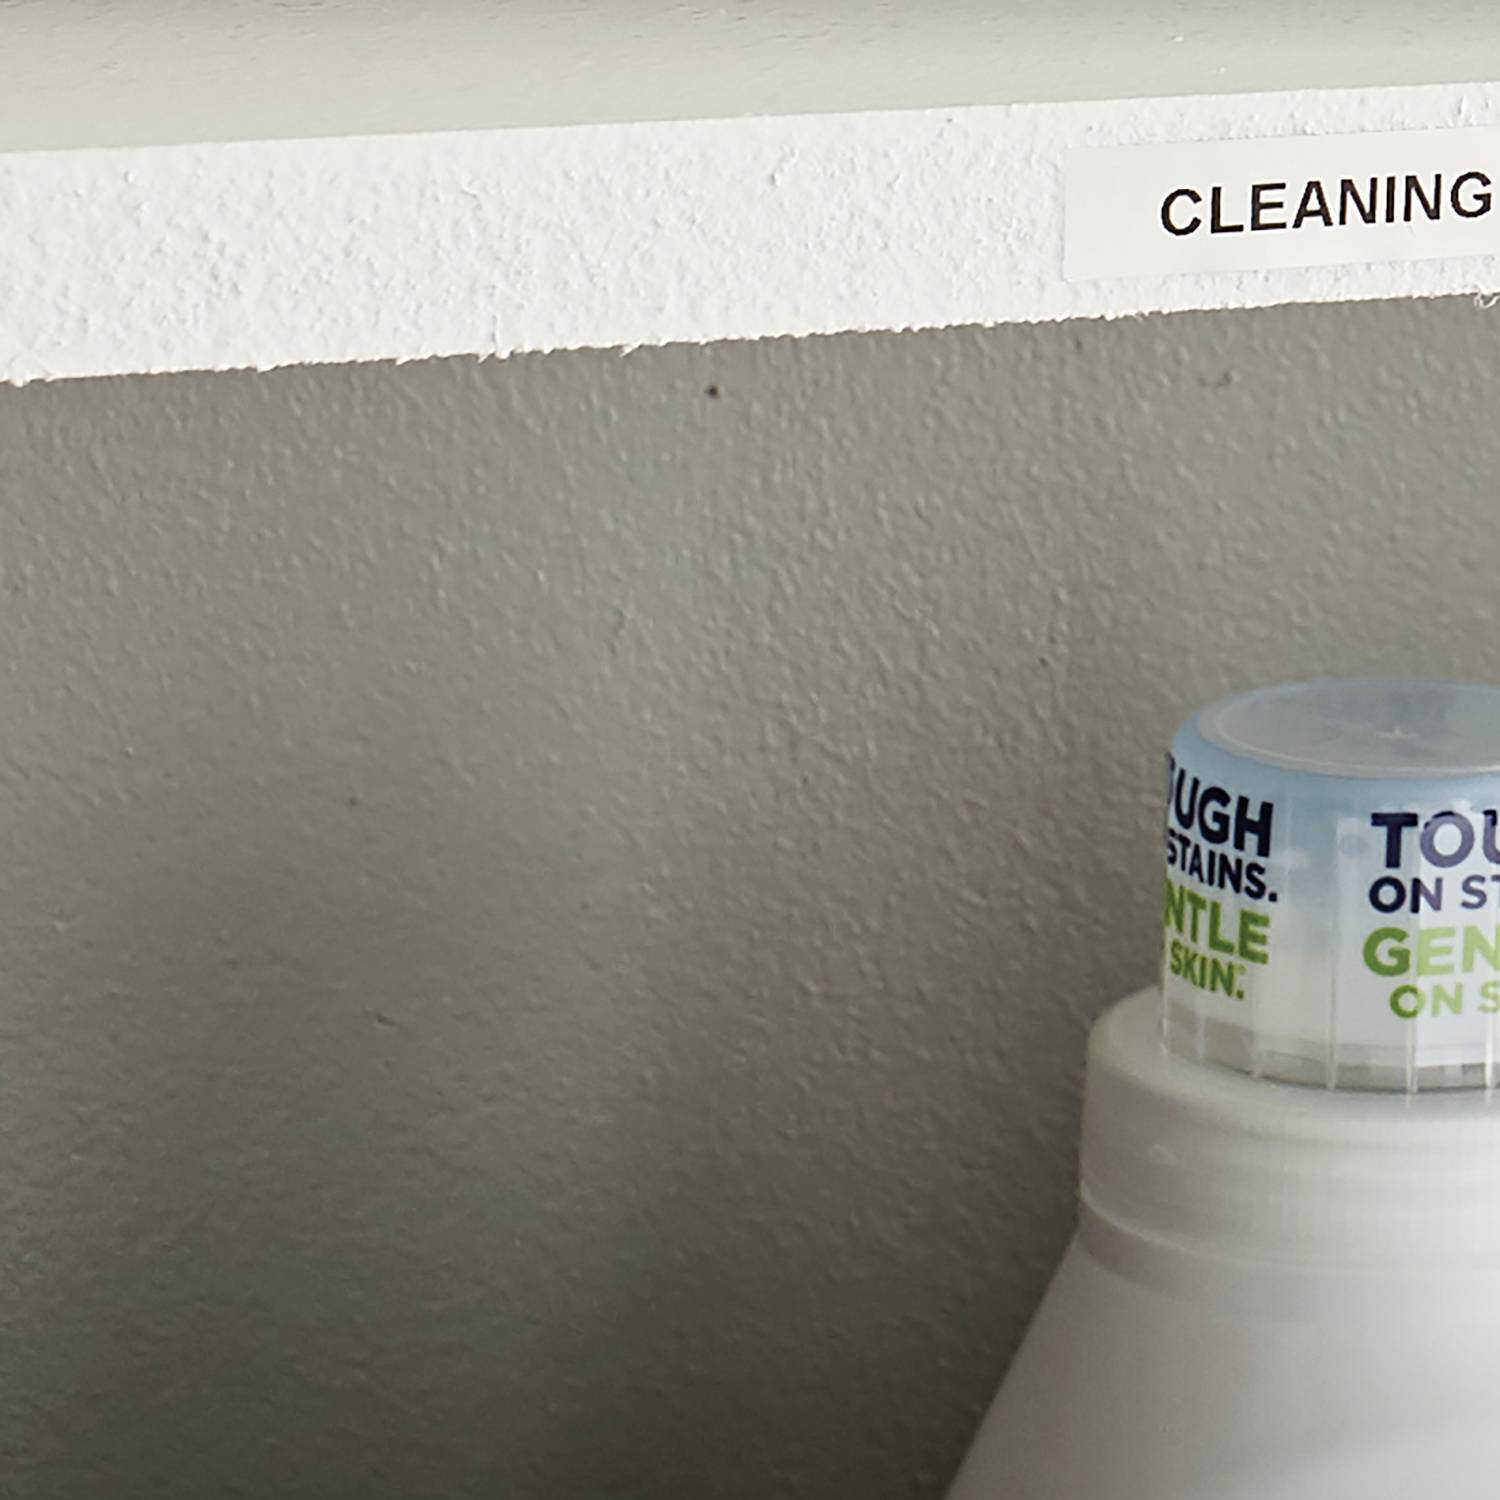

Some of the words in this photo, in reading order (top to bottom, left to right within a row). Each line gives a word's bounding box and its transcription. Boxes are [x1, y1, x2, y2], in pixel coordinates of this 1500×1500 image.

[1160, 171, 1492, 237] CLEANING
[1368, 876, 1443, 914] ON
[1390, 983, 1463, 1019] ON
